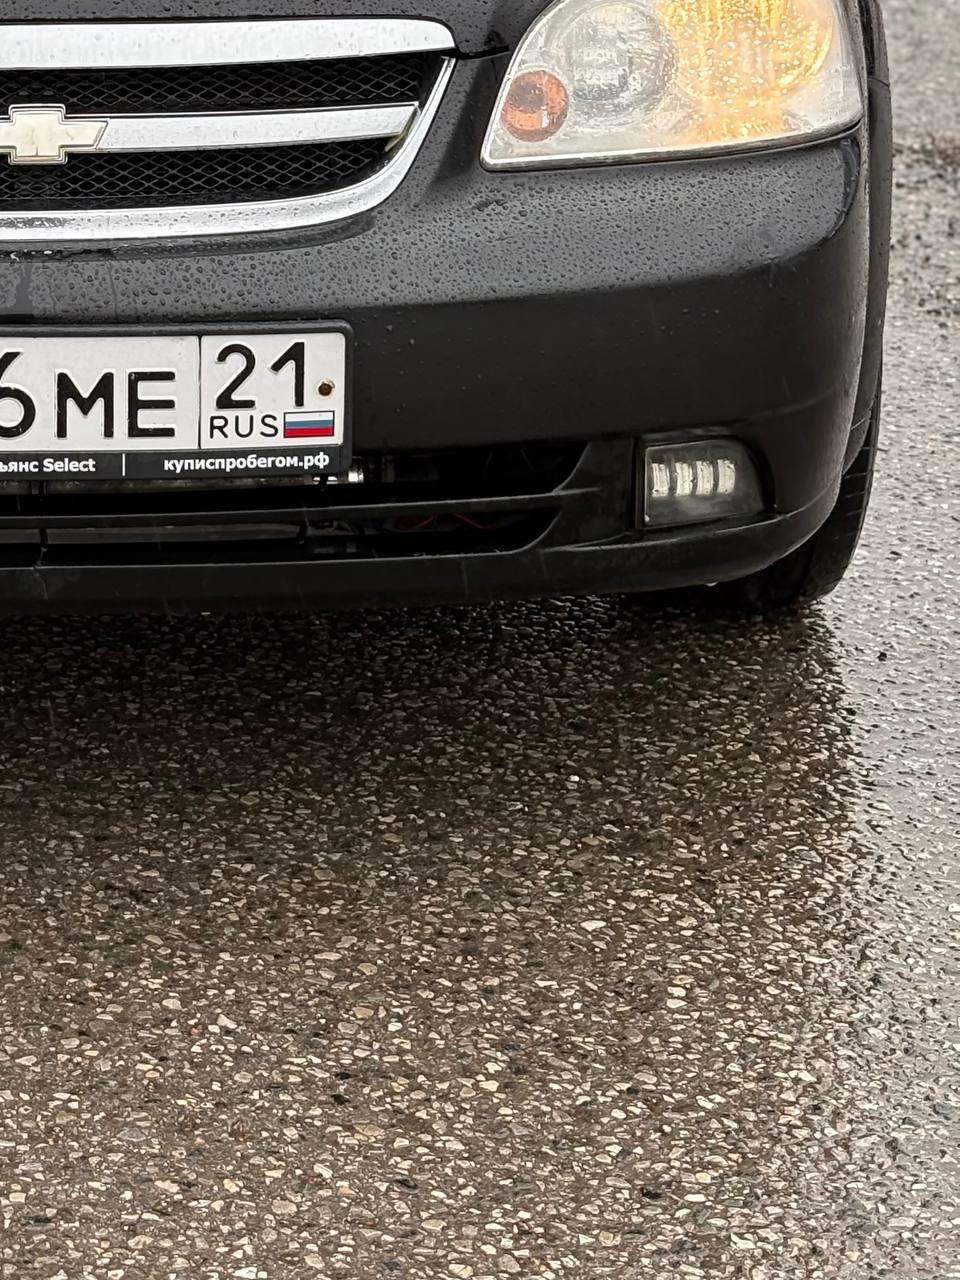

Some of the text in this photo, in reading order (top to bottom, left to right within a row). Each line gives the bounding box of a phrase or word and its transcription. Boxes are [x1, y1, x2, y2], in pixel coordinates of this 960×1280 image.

[215, 341, 306, 410] 21
[209, 414, 279, 439] RUS
[42, 458, 96, 472] Select
[163, 451, 330, 472] куписпробегом.рф
